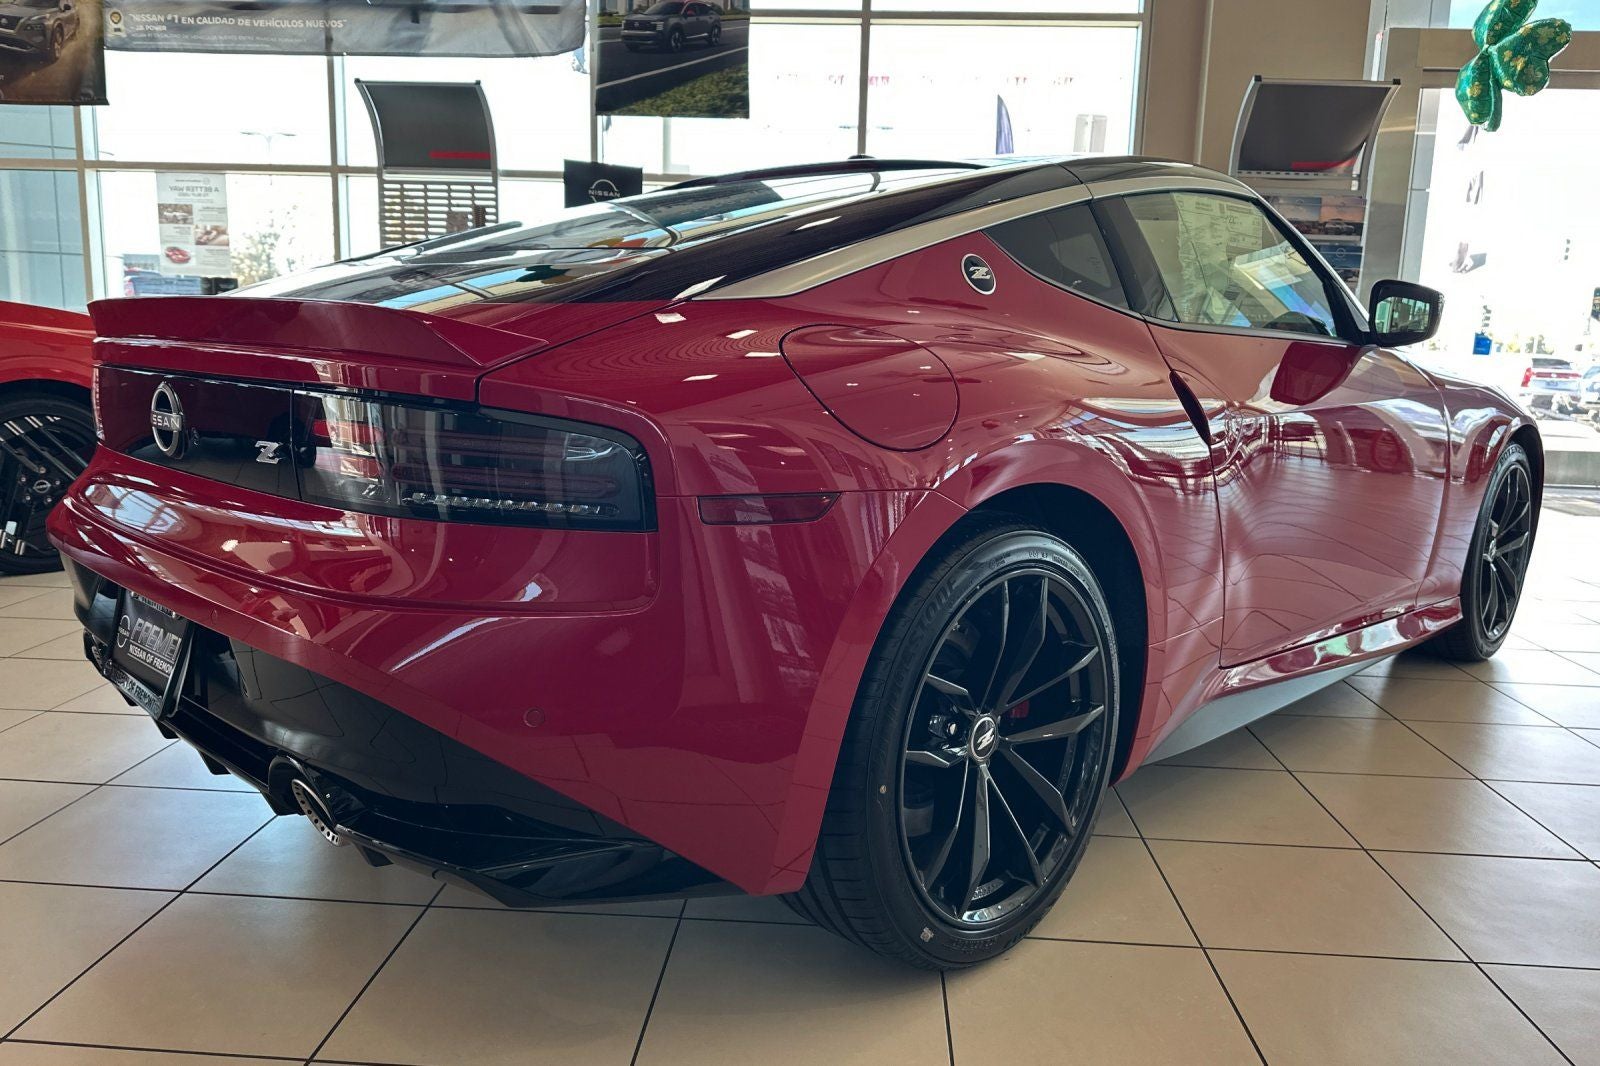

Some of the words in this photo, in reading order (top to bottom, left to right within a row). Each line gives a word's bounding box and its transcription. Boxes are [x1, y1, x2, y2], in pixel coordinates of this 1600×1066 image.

[181, 16, 195, 25] EN
[196, 16, 235, 26] CALIDAD
[237, 18, 251, 26] DE
[252, 18, 304, 29] VEHÍCULOS
[588, 189, 621, 198] NISSAN
[969, 266, 991, 280] Z
[152, 414, 180, 429] SSAN
[254, 440, 284, 465] Z
[131, 617, 182, 661] PREMIE
[129, 644, 147, 660] NISSAN
[146, 653, 154, 664] OF
[153, 657, 173, 675] FREMON
